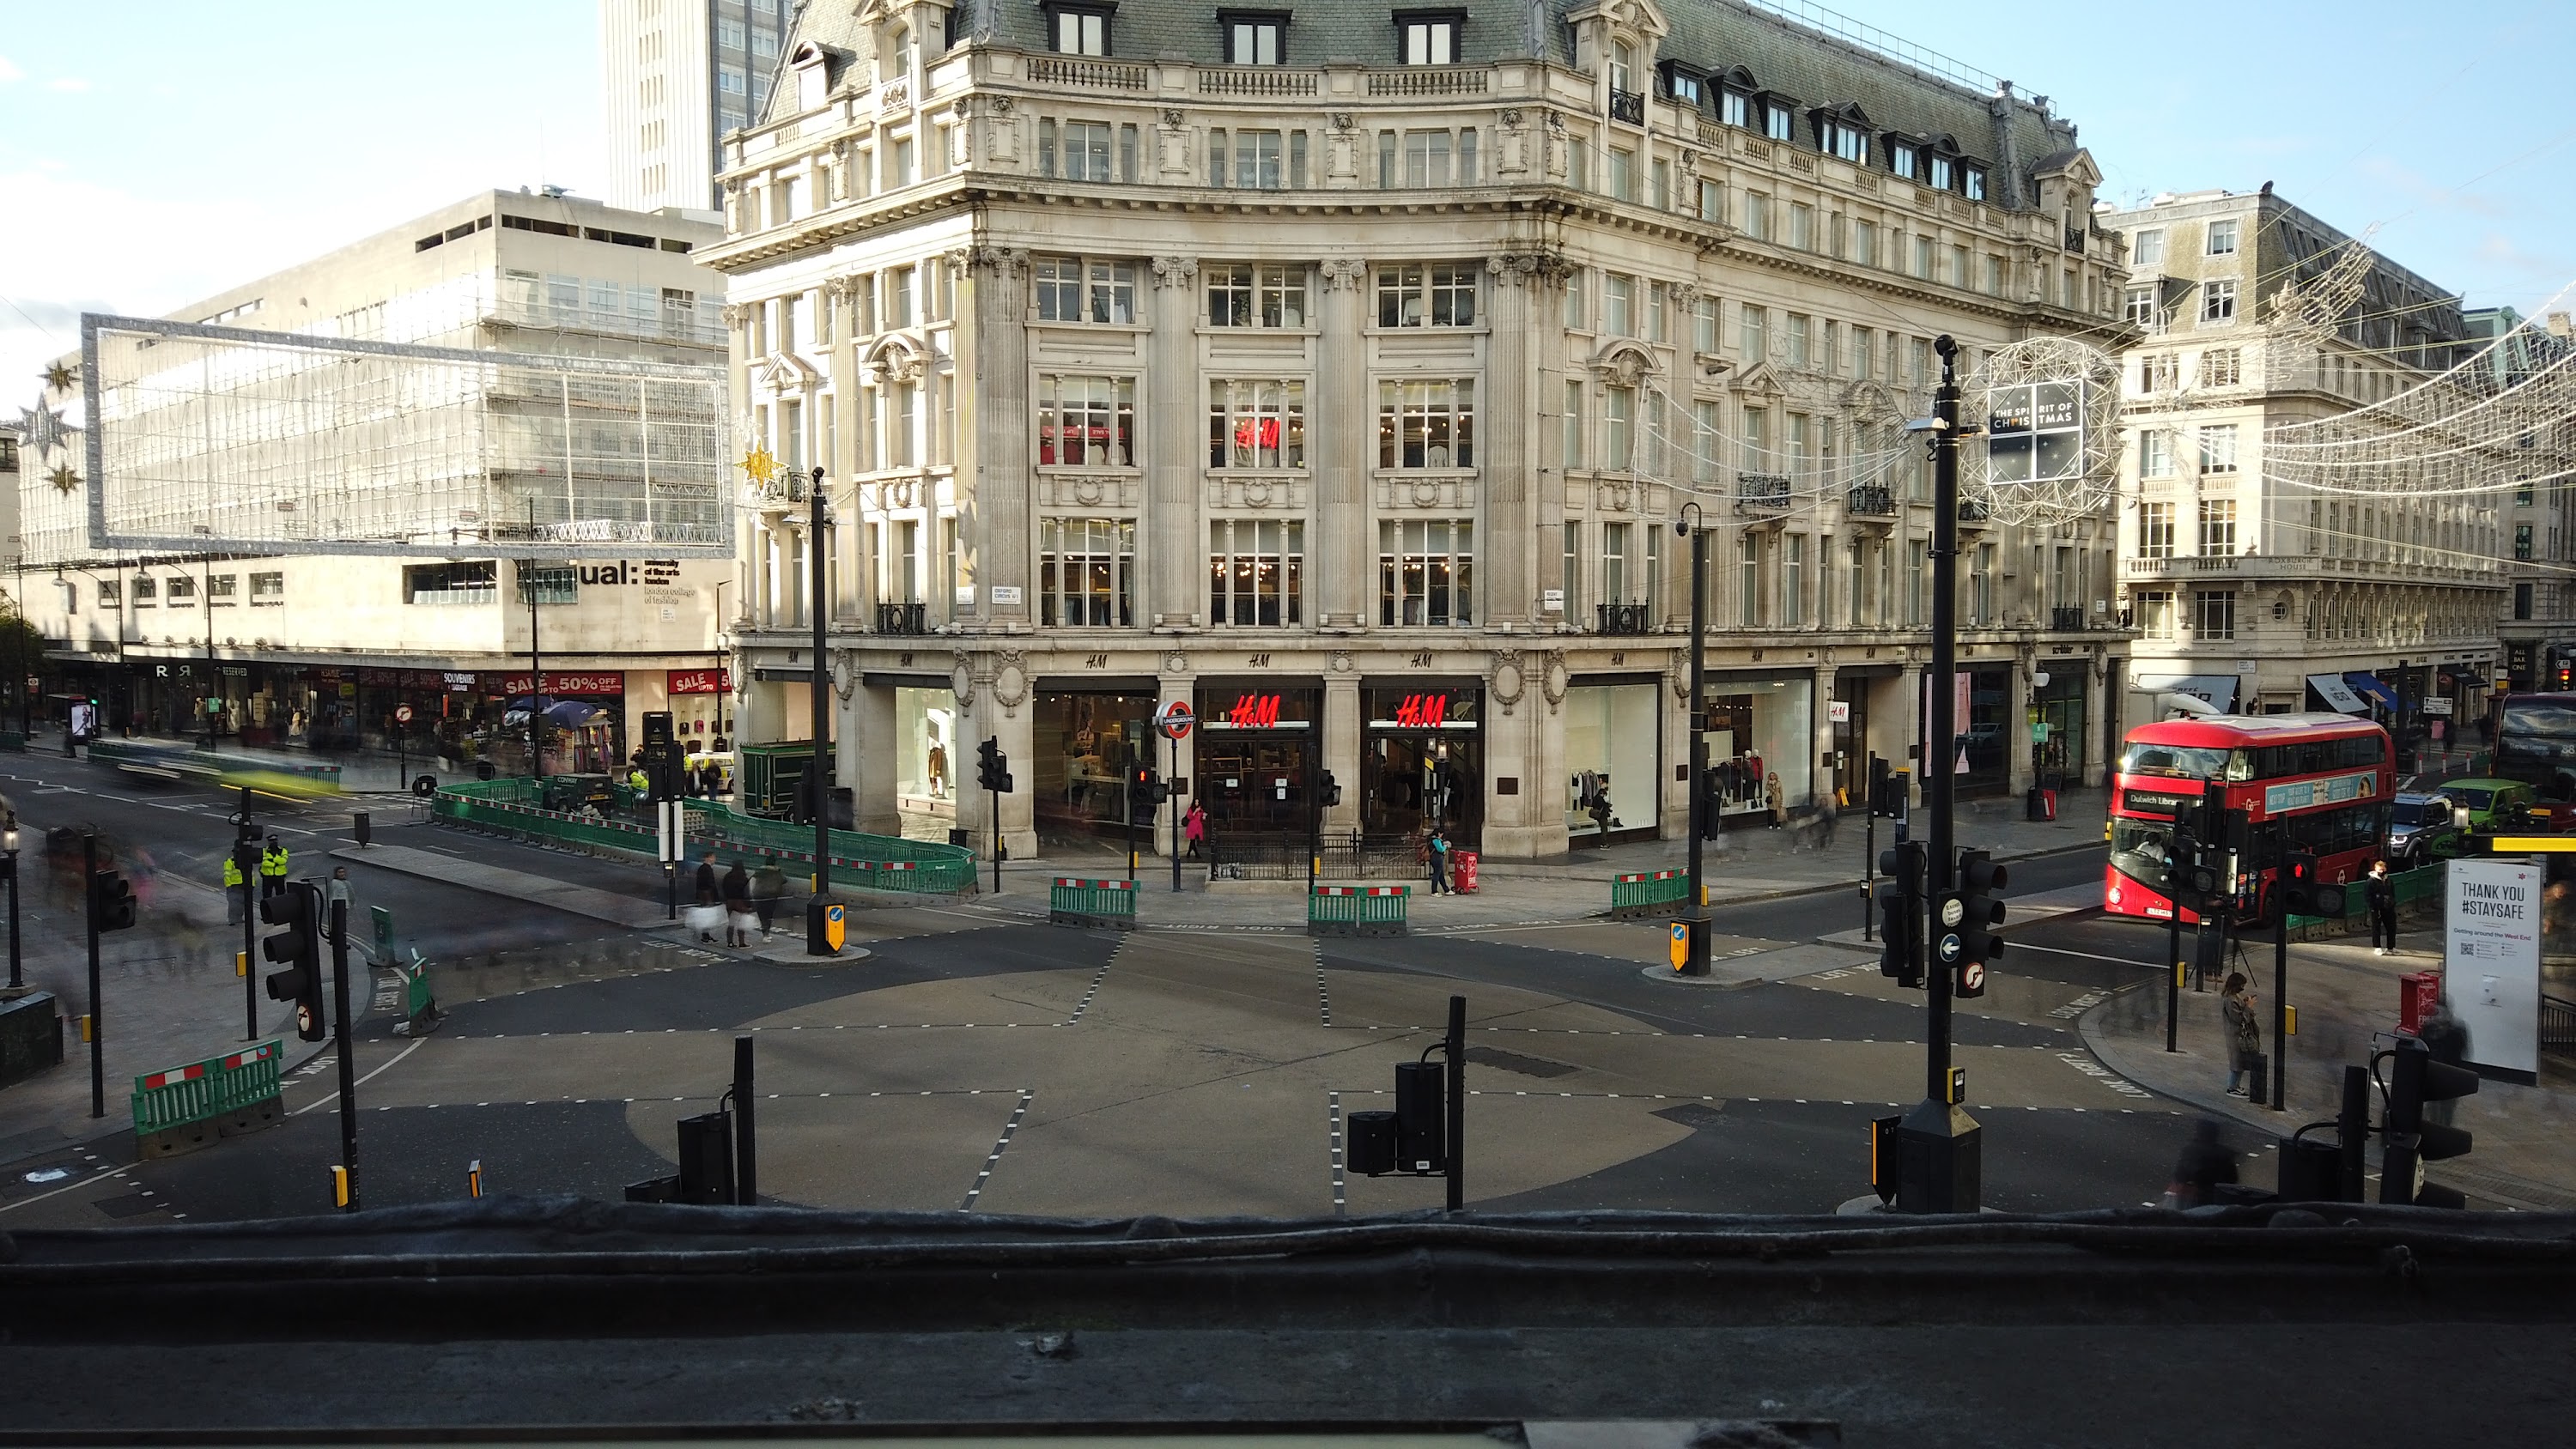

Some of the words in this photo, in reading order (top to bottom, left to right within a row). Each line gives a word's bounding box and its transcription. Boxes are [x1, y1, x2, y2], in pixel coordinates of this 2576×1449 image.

[1996, 409, 2013, 418] THE
[2058, 403, 2073, 411] OF
[644, 577, 670, 585] london
[644, 586, 669, 595] london
[670, 586, 696, 597] college
[644, 596, 652, 604] of
[653, 596, 679, 604] fashion
[1085, 654, 1108, 669] H&M
[1249, 654, 1271, 668] H&M
[1411, 653, 1433, 668] H&M
[1611, 652, 1625, 666] H&M
[1752, 650, 1763, 663] H&M
[155, 665, 168, 677] R
[222, 666, 248, 676] RESERVED
[443, 672, 476, 684] SOUVENIRS
[506, 677, 548, 694] SALE
[559, 677, 598, 691] 50%
[676, 672, 706, 692] SALE
[721, 675, 731, 687] 5
[1230, 694, 1281, 729] H&M
[1396, 694, 1446, 728] H&M
[1831, 706, 1846, 718] H&M
[1163, 716, 1194, 724] UNDERGROUND
[2130, 794, 2157, 804] Dulwich
[2158, 795, 2178, 806] Librar
[2462, 882, 2500, 900] THANK
[2502, 885, 2524, 902] YOU
[2462, 900, 2524, 920] #STAYSAFE
[2453, 927, 2473, 937] Getting
[294, 1056, 338, 1076] LOOK
[2061, 1058, 2114, 1076] RIGHT
[2099, 1079, 2153, 1099] LOOK
